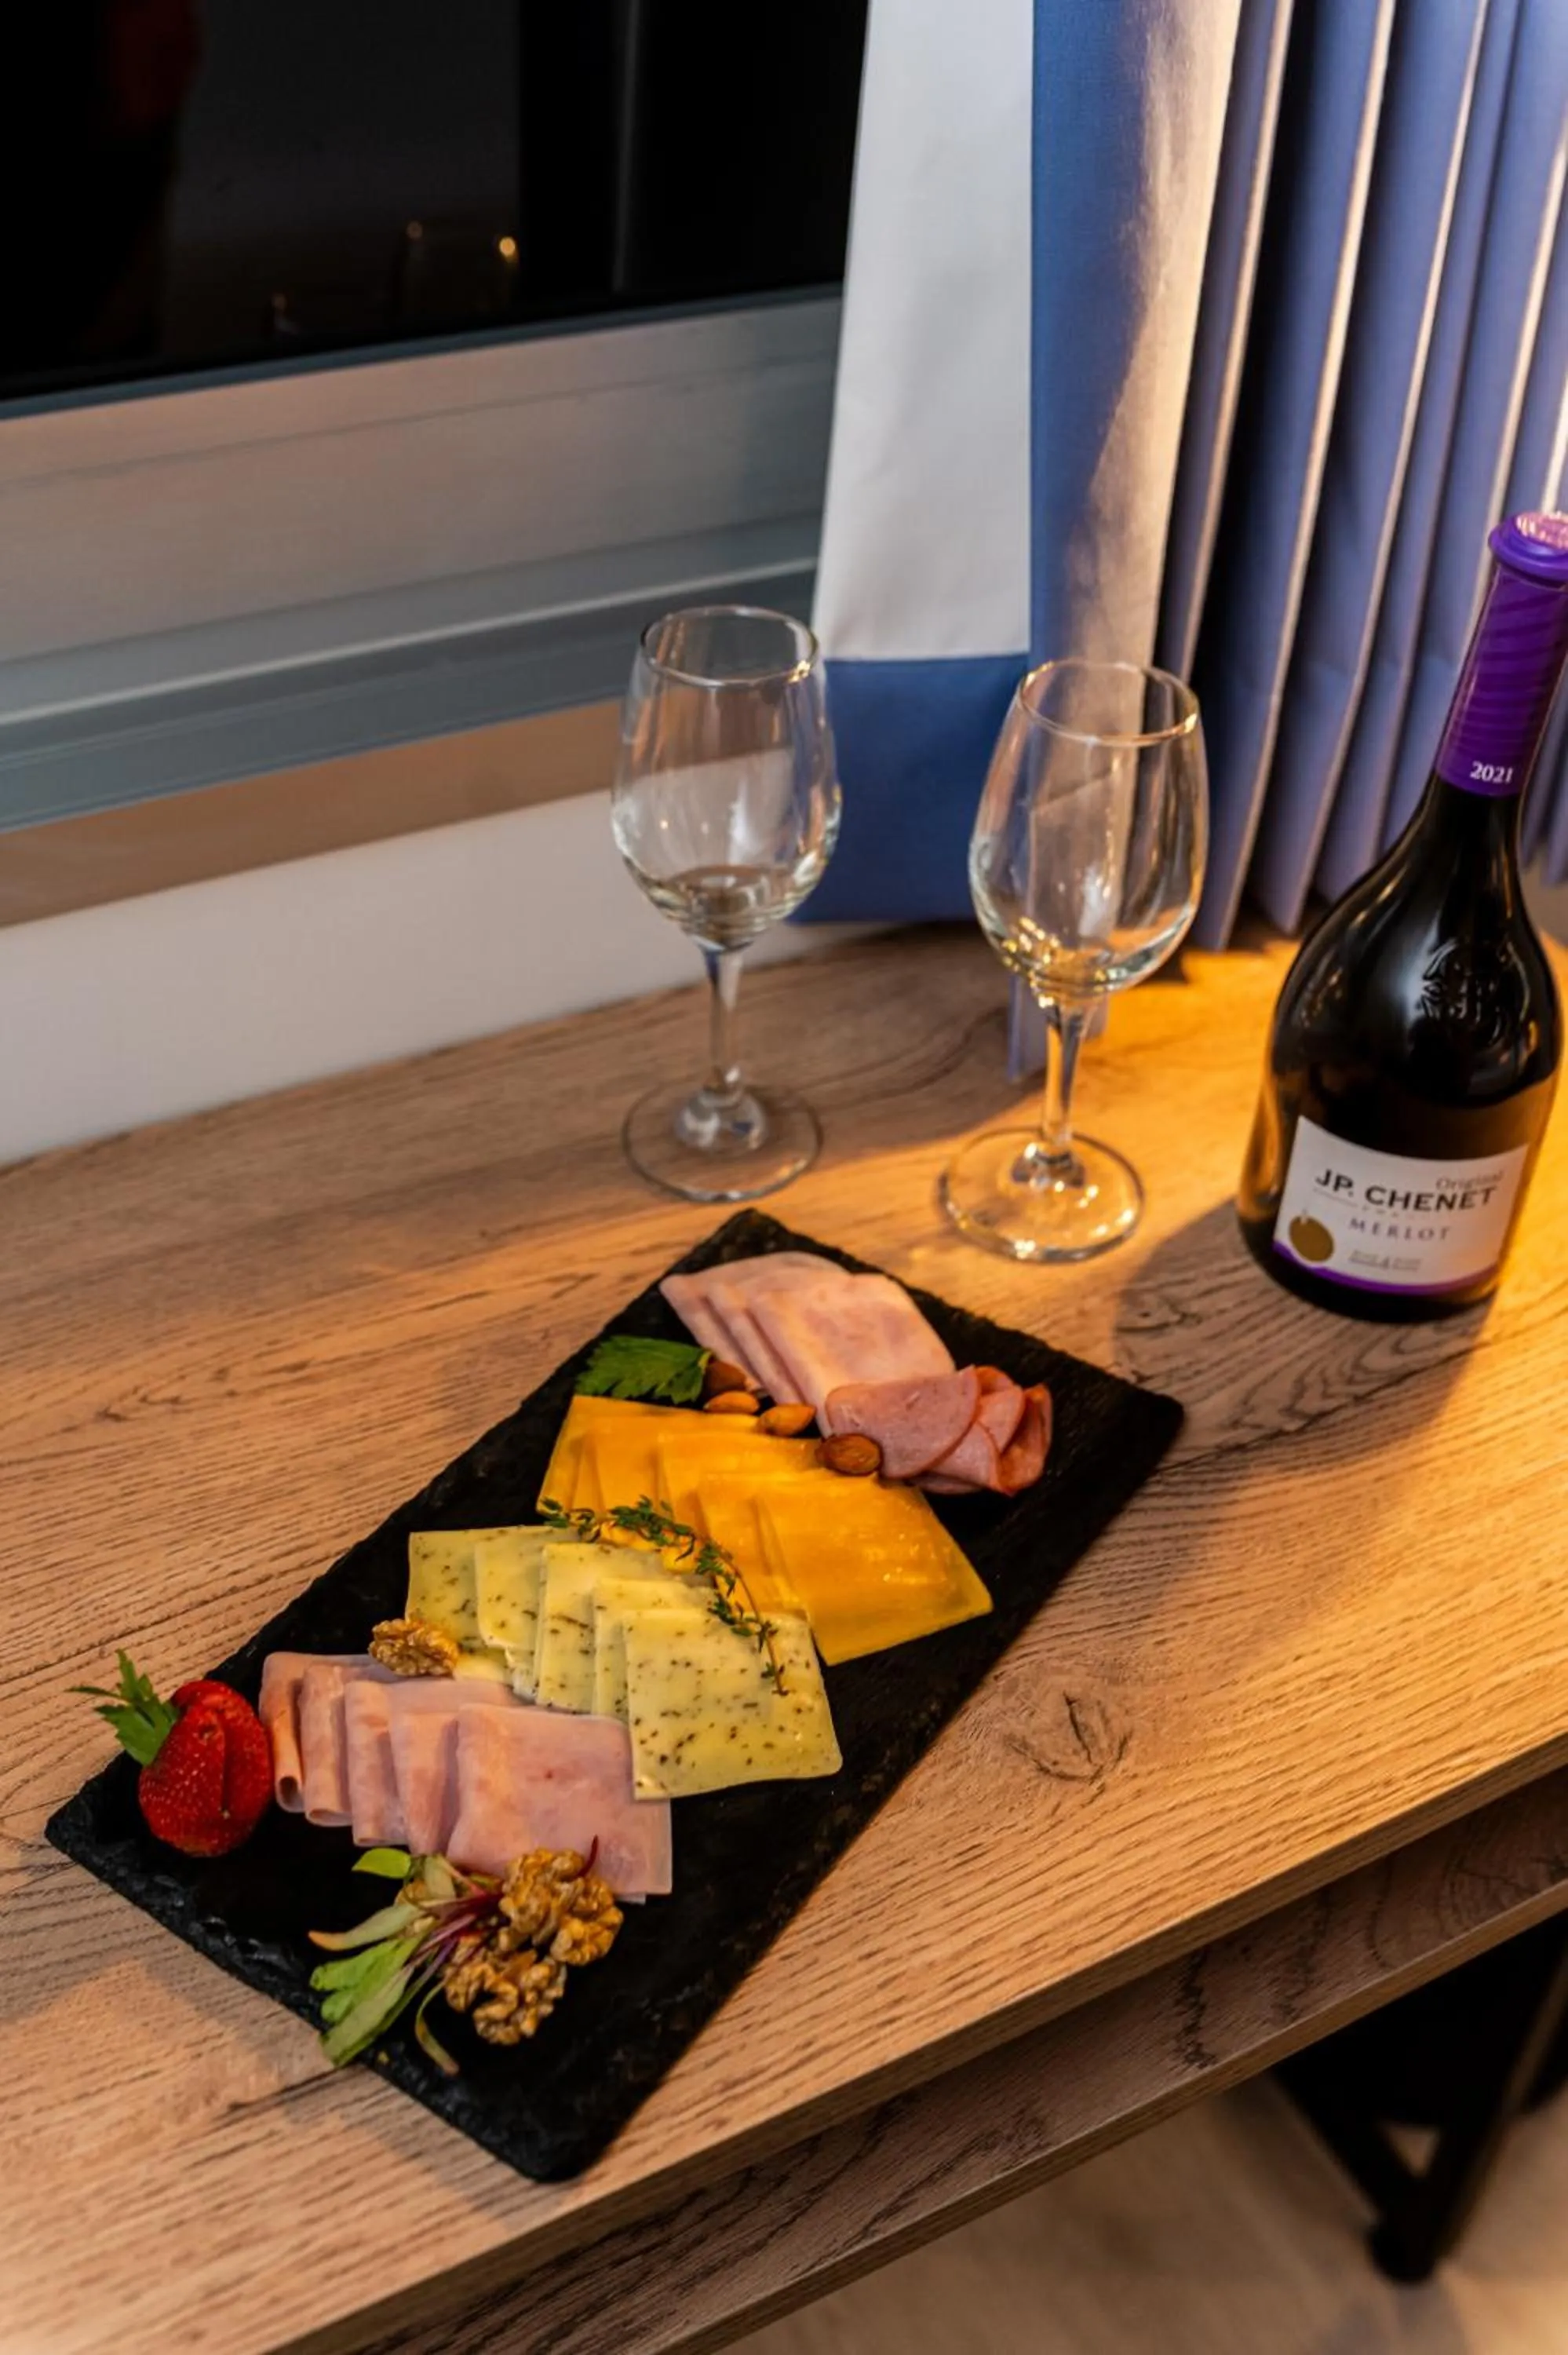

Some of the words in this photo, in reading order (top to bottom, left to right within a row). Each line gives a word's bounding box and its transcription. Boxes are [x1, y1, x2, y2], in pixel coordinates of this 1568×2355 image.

[1470, 761, 1514, 783] 2021
[1365, 1185, 1498, 1211] CHENET
[1348, 1218, 1452, 1242] MERLOT
